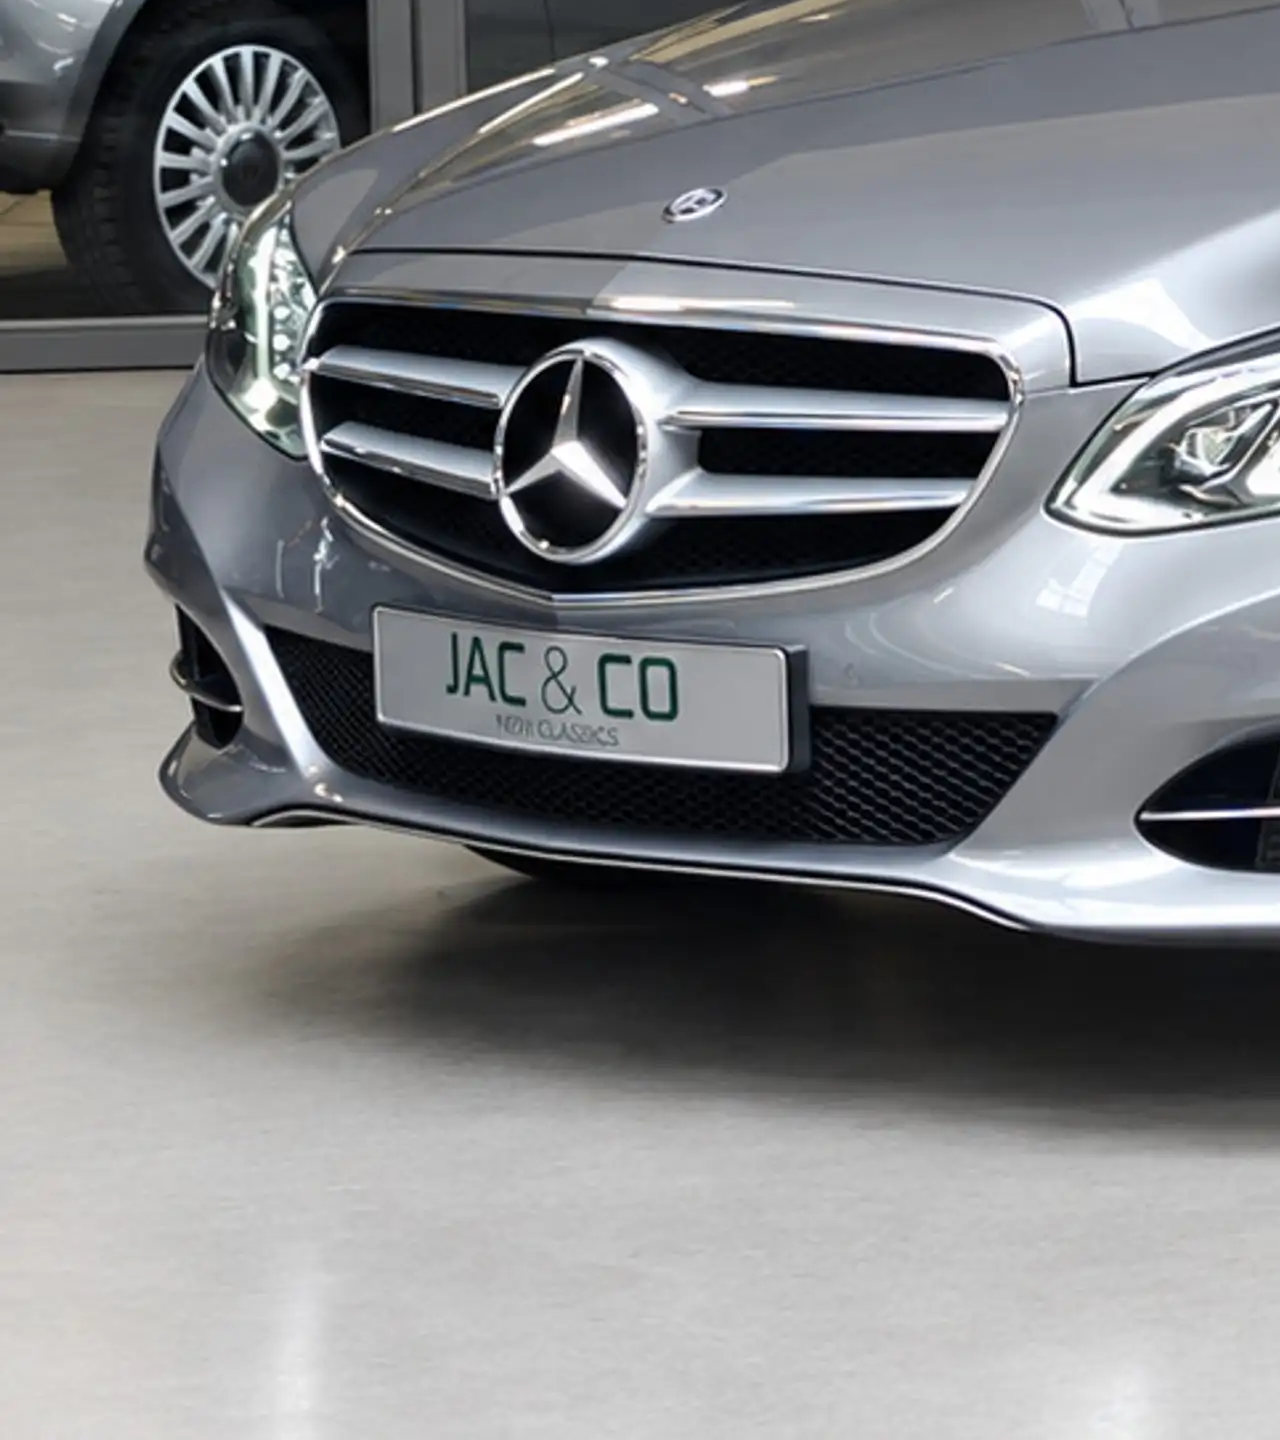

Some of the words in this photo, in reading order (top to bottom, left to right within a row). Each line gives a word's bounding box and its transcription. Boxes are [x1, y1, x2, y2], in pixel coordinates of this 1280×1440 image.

[446, 631, 527, 708] JAC
[541, 646, 582, 715] &
[597, 653, 679, 722] CO
